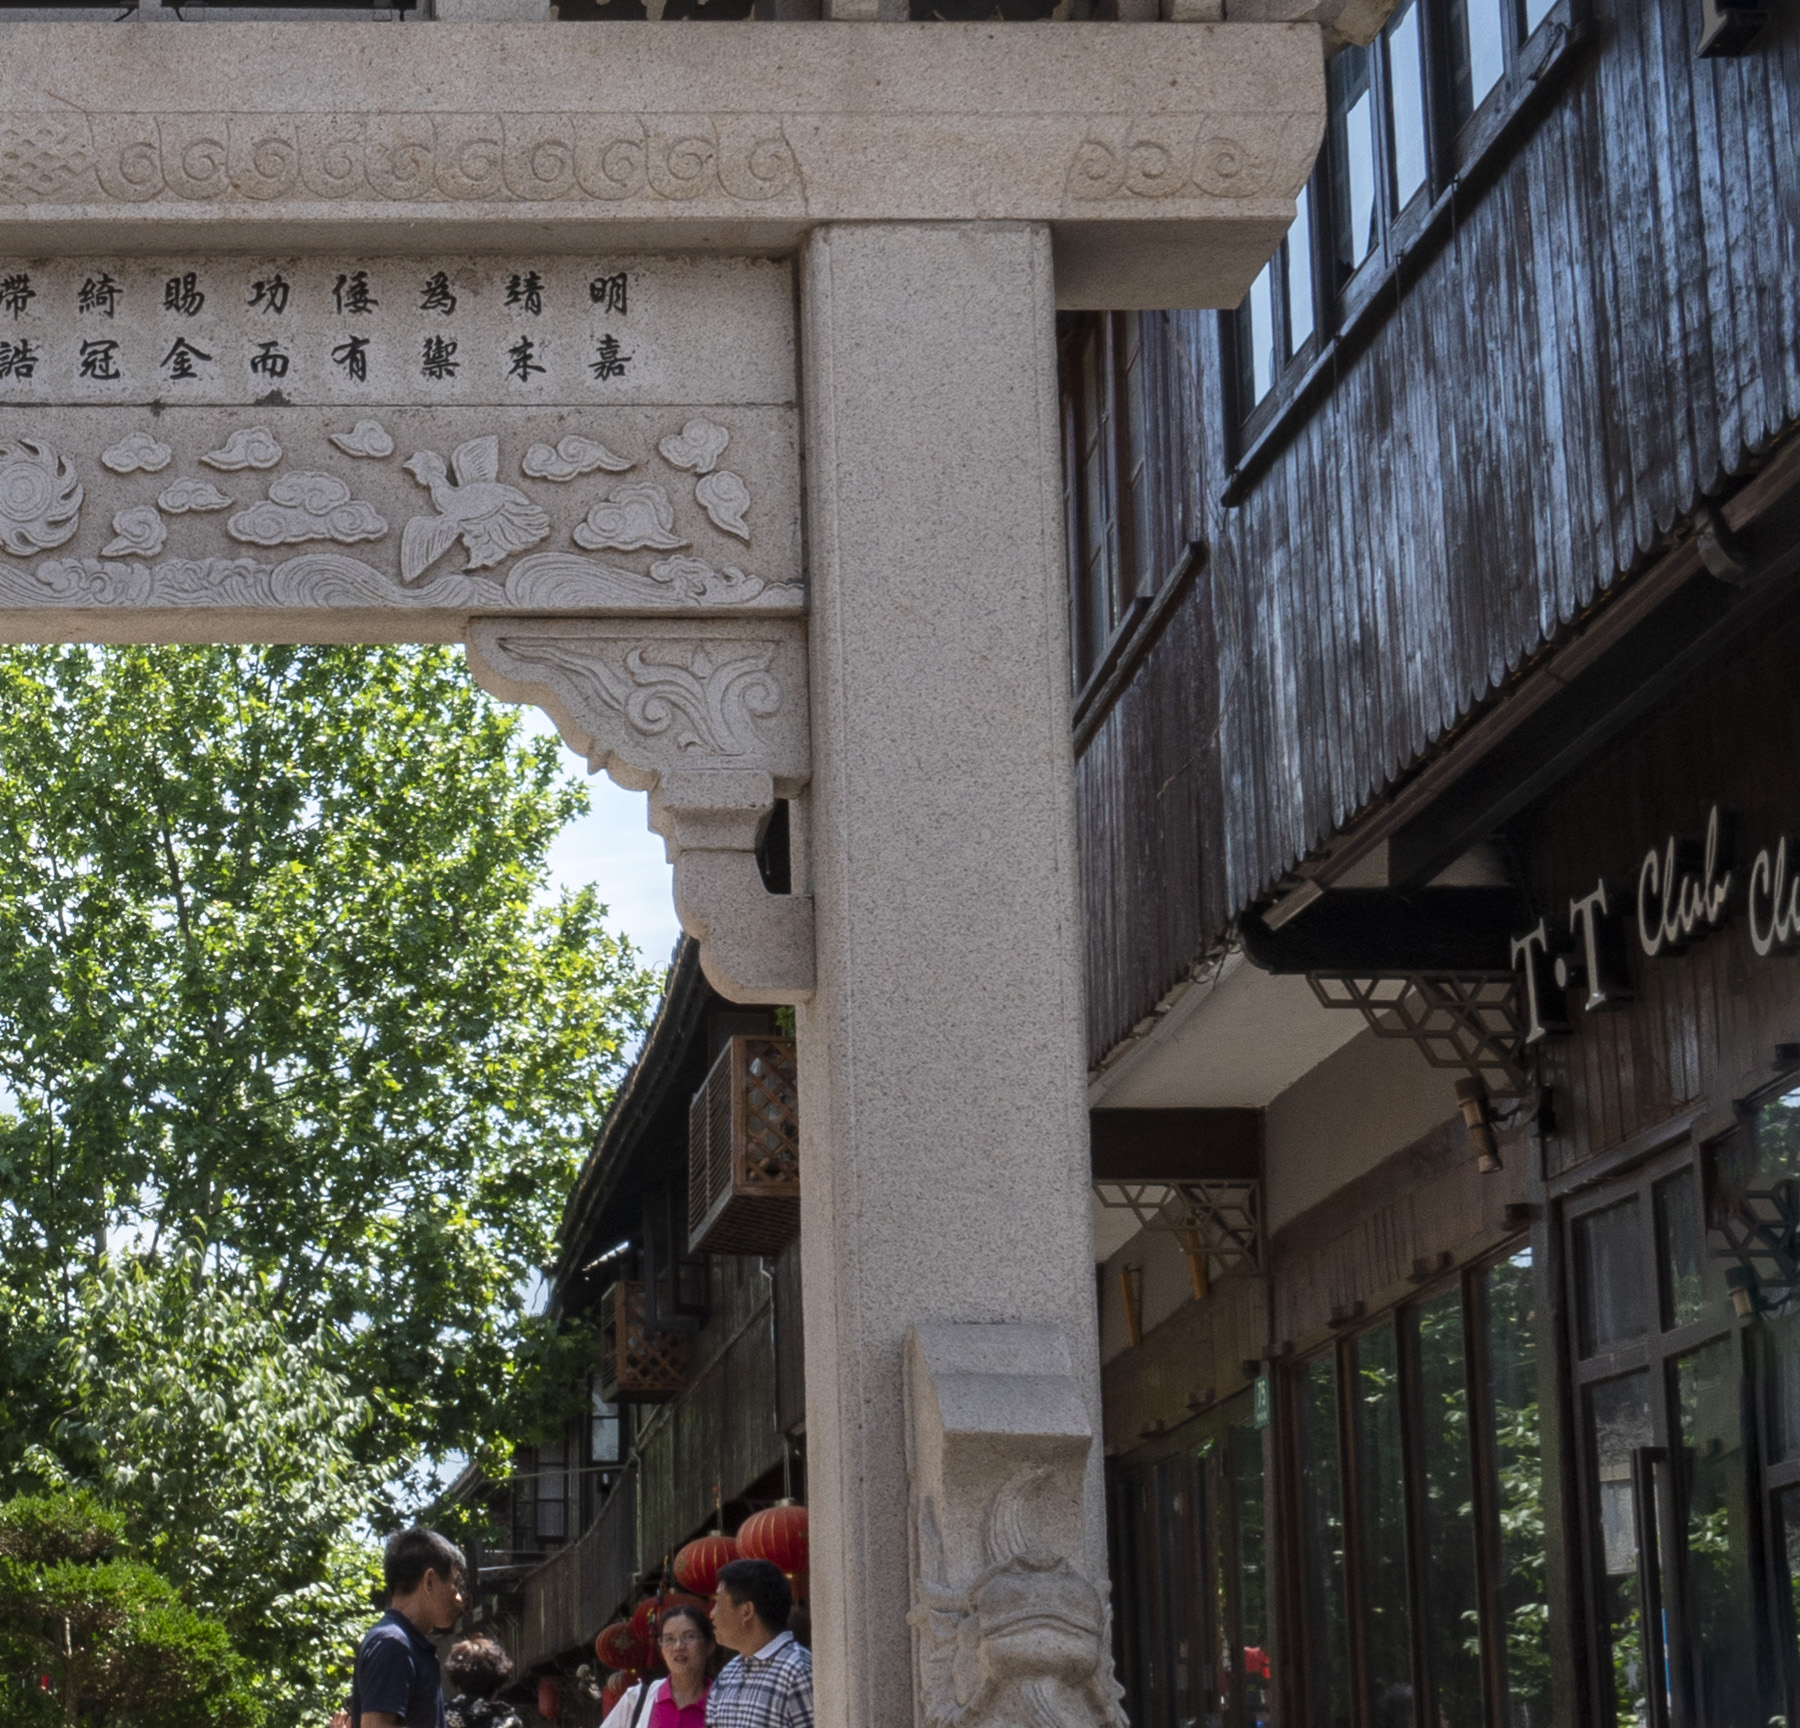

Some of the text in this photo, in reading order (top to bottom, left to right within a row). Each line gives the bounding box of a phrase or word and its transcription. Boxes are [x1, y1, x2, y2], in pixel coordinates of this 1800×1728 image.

[77, 273, 123, 381] 綺冠
[160, 272, 213, 380] 賜金
[247, 274, 290, 379] 功而
[331, 271, 379, 383] 倭有
[504, 271, 547, 383] 靖末
[590, 272, 632, 382] 明嘉
[1637, 804, 1732, 957] Club
